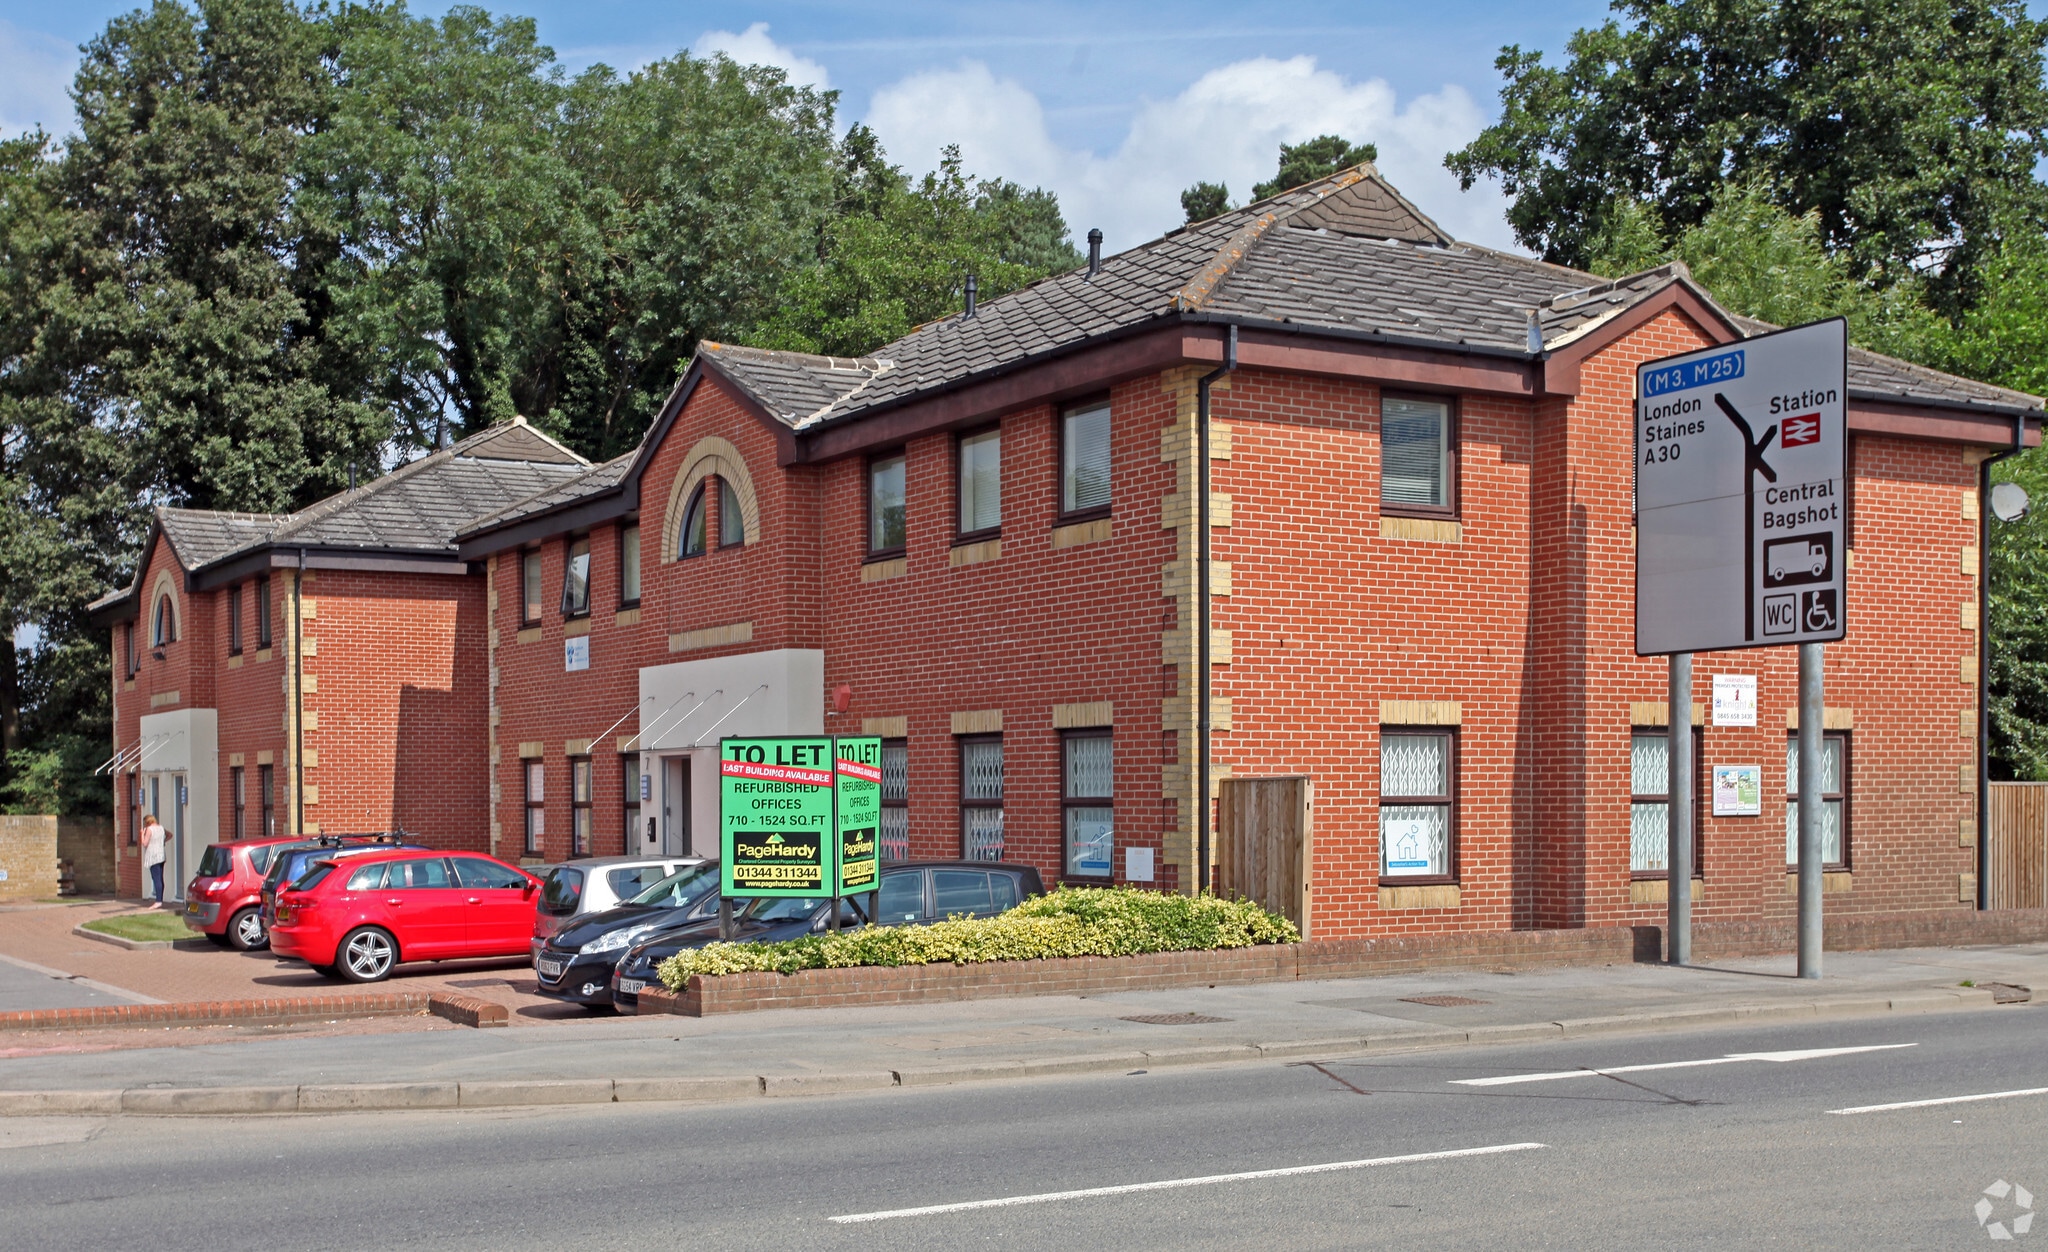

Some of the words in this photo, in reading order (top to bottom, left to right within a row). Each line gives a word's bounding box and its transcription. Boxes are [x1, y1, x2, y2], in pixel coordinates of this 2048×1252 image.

[1644, 398, 1701, 421] London
[1769, 389, 1837, 414] Station
[1645, 420, 1705, 443] Staines
[1644, 443, 1681, 465] A30
[1765, 478, 1834, 505] Central
[1763, 502, 1838, 529] Bagshot
[1767, 603, 1792, 626] WC
[729, 745, 765, 764] TO
[776, 745, 825, 766] LET
[839, 744, 855, 762] TO
[859, 744, 878, 764] LET
[723, 764, 744, 773] LAST
[745, 766, 784, 778] BUILDING
[785, 771, 830, 782] AVAILABLE
[734, 783, 819, 793] REFURBISHED
[842, 780, 876, 792] REFURBISHED
[751, 799, 802, 809] OFFICES
[850, 796, 870, 808] OFFICES
[729, 815, 748, 825] 710
[760, 815, 786, 825] 1524
[789, 815, 826, 826] SQ.FT
[840, 814, 849, 825] 710
[853, 812, 864, 824] 1524
[737, 844, 817, 859] PageHardy
[844, 840, 874, 856] PageHardy
[737, 867, 772, 878] 01344
[775, 867, 818, 878] 311344
[844, 864, 858, 877] 01344
[858, 861, 874, 874] 311344
